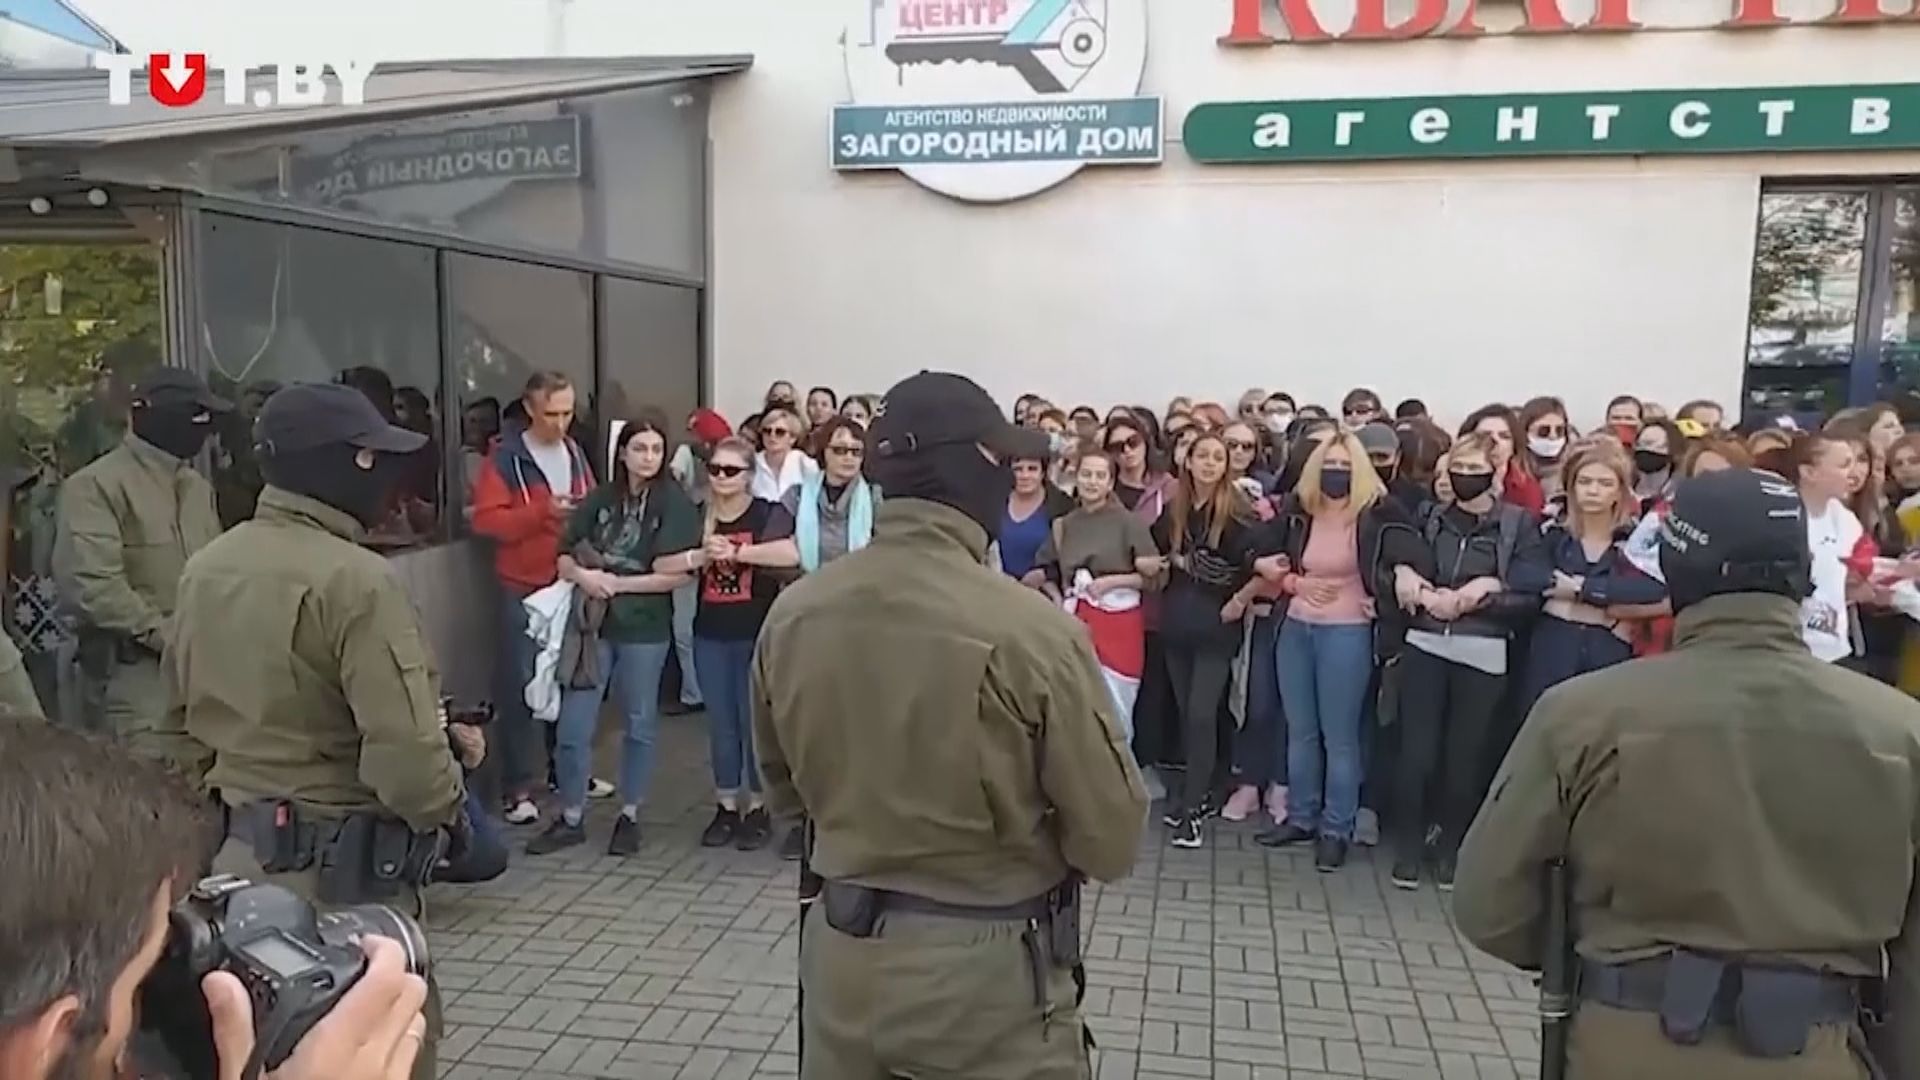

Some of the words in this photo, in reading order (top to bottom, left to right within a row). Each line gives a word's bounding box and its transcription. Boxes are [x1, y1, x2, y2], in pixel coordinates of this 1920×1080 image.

[900, 0, 1008, 31] ЦЕНТР
[885, 110, 973, 127] АГЕНТСТВО
[976, 104, 1107, 125] НЕДВИЖИМОСТИ
[840, 124, 1067, 160] ЗАГОРОДНЫЙ
[1077, 126, 1153, 155] ДОМ
